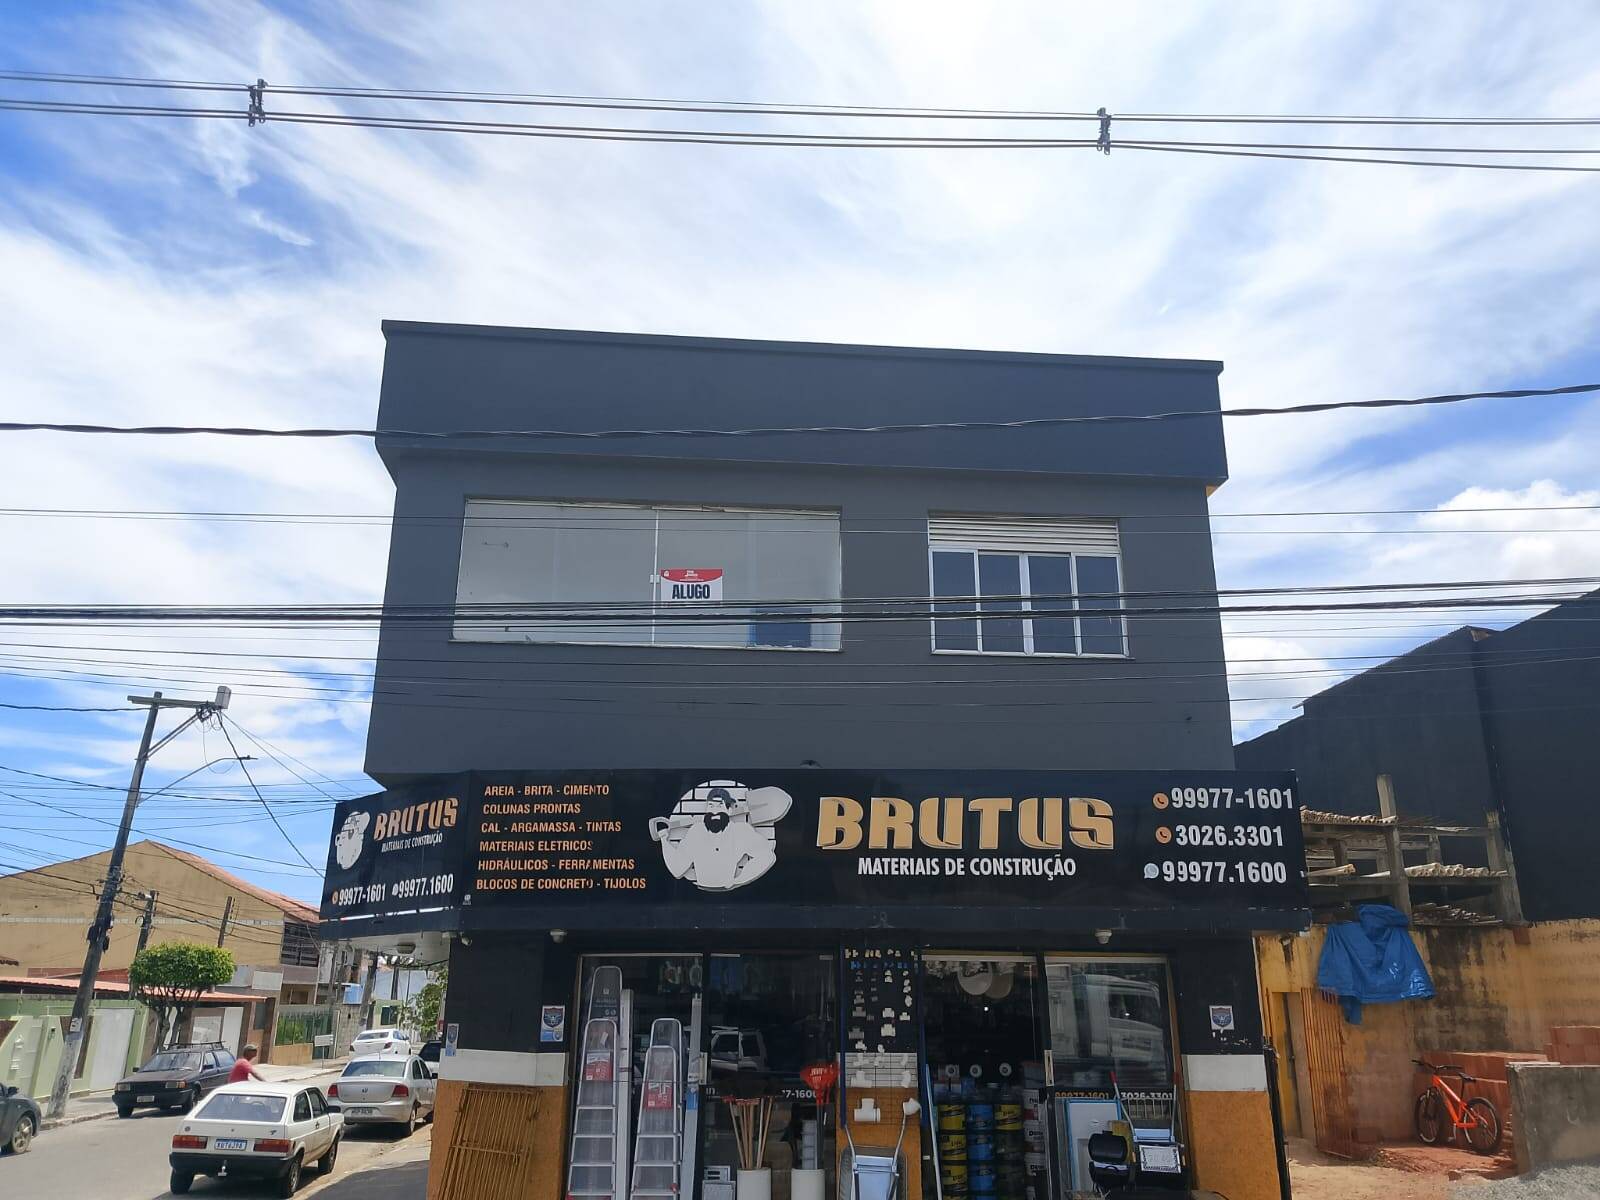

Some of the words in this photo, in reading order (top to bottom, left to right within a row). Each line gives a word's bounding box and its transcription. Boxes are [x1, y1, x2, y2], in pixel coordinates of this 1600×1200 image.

[672, 584, 711, 600] ALUGO
[484, 786, 515, 796] AREIA
[524, 785, 553, 796] BRITA
[563, 784, 610, 796] CIMENTO
[1171, 787, 1293, 809] 99977-1601
[373, 797, 459, 841] BRUTUS
[483, 803, 531, 815] COLUNAS
[533, 803, 581, 815] PRONTAS
[481, 822, 501, 833] CAL
[511, 822, 576, 833] ARGAMASSA
[586, 821, 622, 832] TINTAS
[816, 796, 1115, 850] BRUTUS
[381, 840, 404, 853] MATERIAIS
[404, 838, 413, 849] DE
[411, 830, 443, 848] CONSTRUÇÃO
[479, 840, 535, 852] MATERIAIS
[537, 840, 594, 851] ELETRICOS
[1175, 824, 1283, 846] 3026.3301
[478, 858, 549, 871] HIDRÁULICOS
[559, 859, 635, 870] FERRAMENTAS
[858, 857, 940, 876] MATERIAIS
[945, 857, 965, 876] DE
[970, 854, 1076, 881] CONSTRUÇÃO
[1162, 860, 1287, 883] 99977.1600
[338, 883, 386, 906] 99977-1601
[398, 873, 454, 899] 99977.1600
[476, 879, 518, 890] BLOCOS
[520, 879, 535, 889] DE
[537, 878, 594, 889] CONCRETO
[604, 878, 646, 889] TIJOLOS
